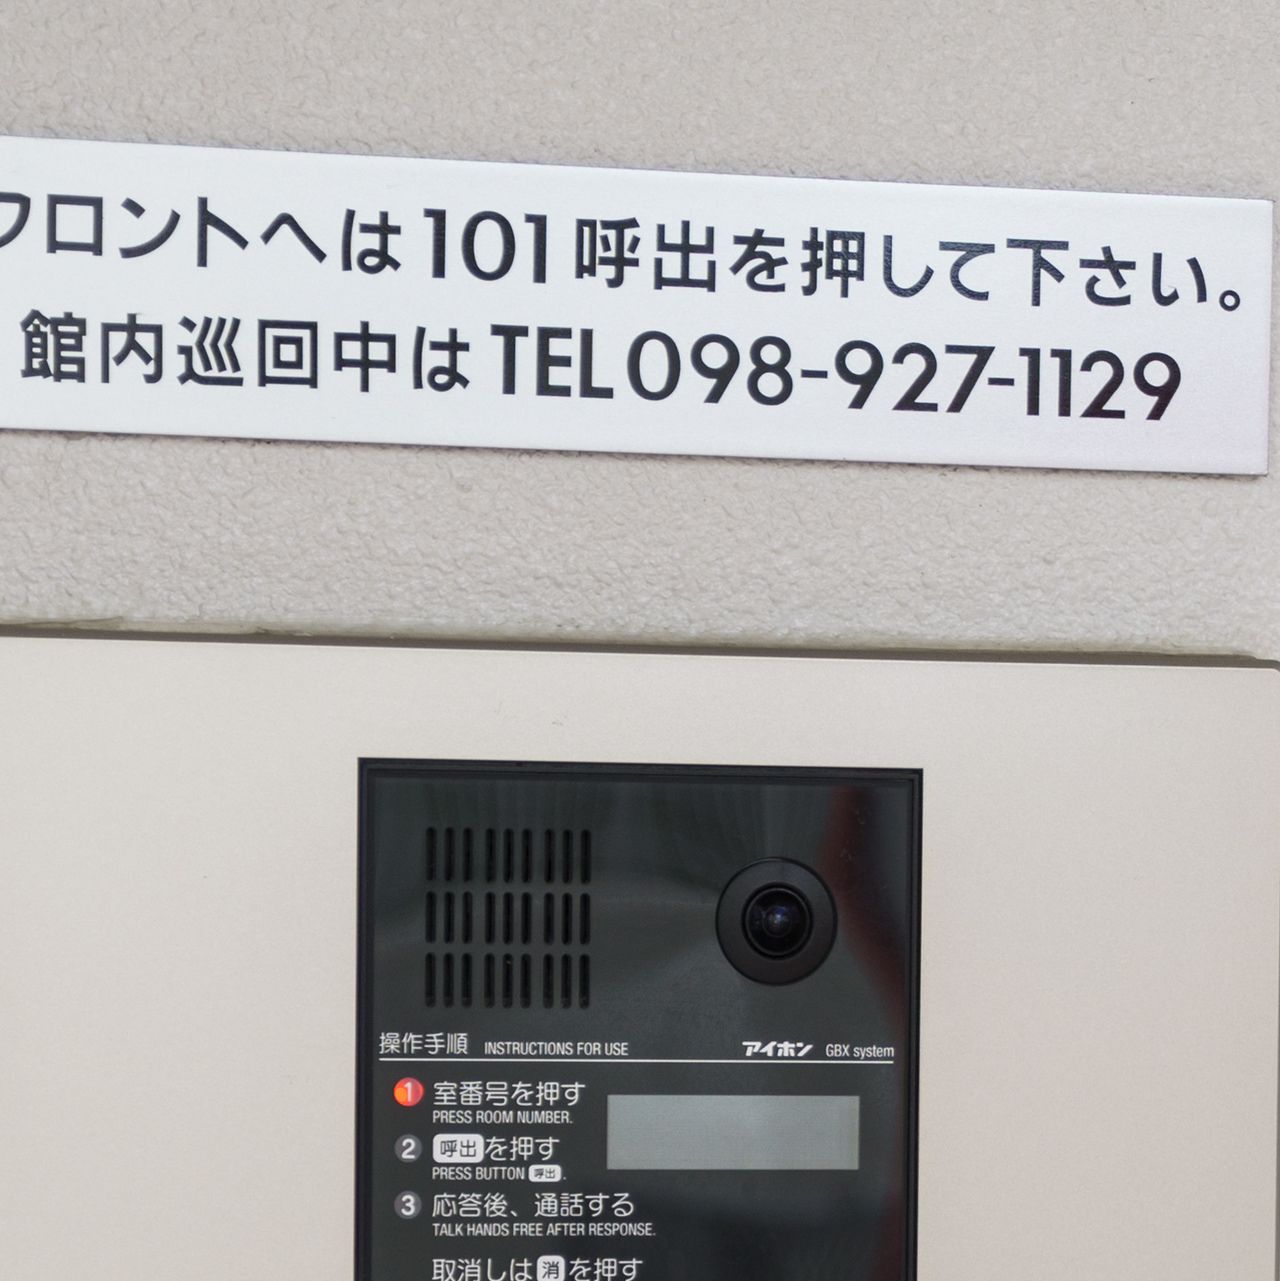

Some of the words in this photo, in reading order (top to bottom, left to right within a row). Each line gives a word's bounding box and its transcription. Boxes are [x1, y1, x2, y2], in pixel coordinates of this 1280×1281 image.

[378, 1031, 468, 1055] 操作手順
[484, 1041, 574, 1056] INSTRUCTIONS
[576, 1042, 602, 1056] FOR
[604, 1042, 629, 1056] USE
[741, 1040, 814, 1057] アイホン
[825, 1043, 850, 1058] GBX
[852, 1044, 895, 1060] system
[433, 1080, 586, 1107] 室番号を押す
[432, 1109, 473, 1124] PRESS
[475, 1110, 514, 1124] ROOM
[516, 1110, 574, 1125] NUMBER.
[401, 1138, 416, 1159] 2
[431, 1166, 473, 1181] PRESS
[475, 1166, 526, 1182] BUTTON
[401, 1194, 415, 1216] 3
[432, 1192, 634, 1218] 応答後、通話する
[431, 1222, 464, 1237] TALK
[466, 1222, 510, 1237] HANDS
[512, 1222, 544, 1237] FREE
[545, 1222, 586, 1237] AFTER
[588, 1222, 656, 1237] RESPONSE.
